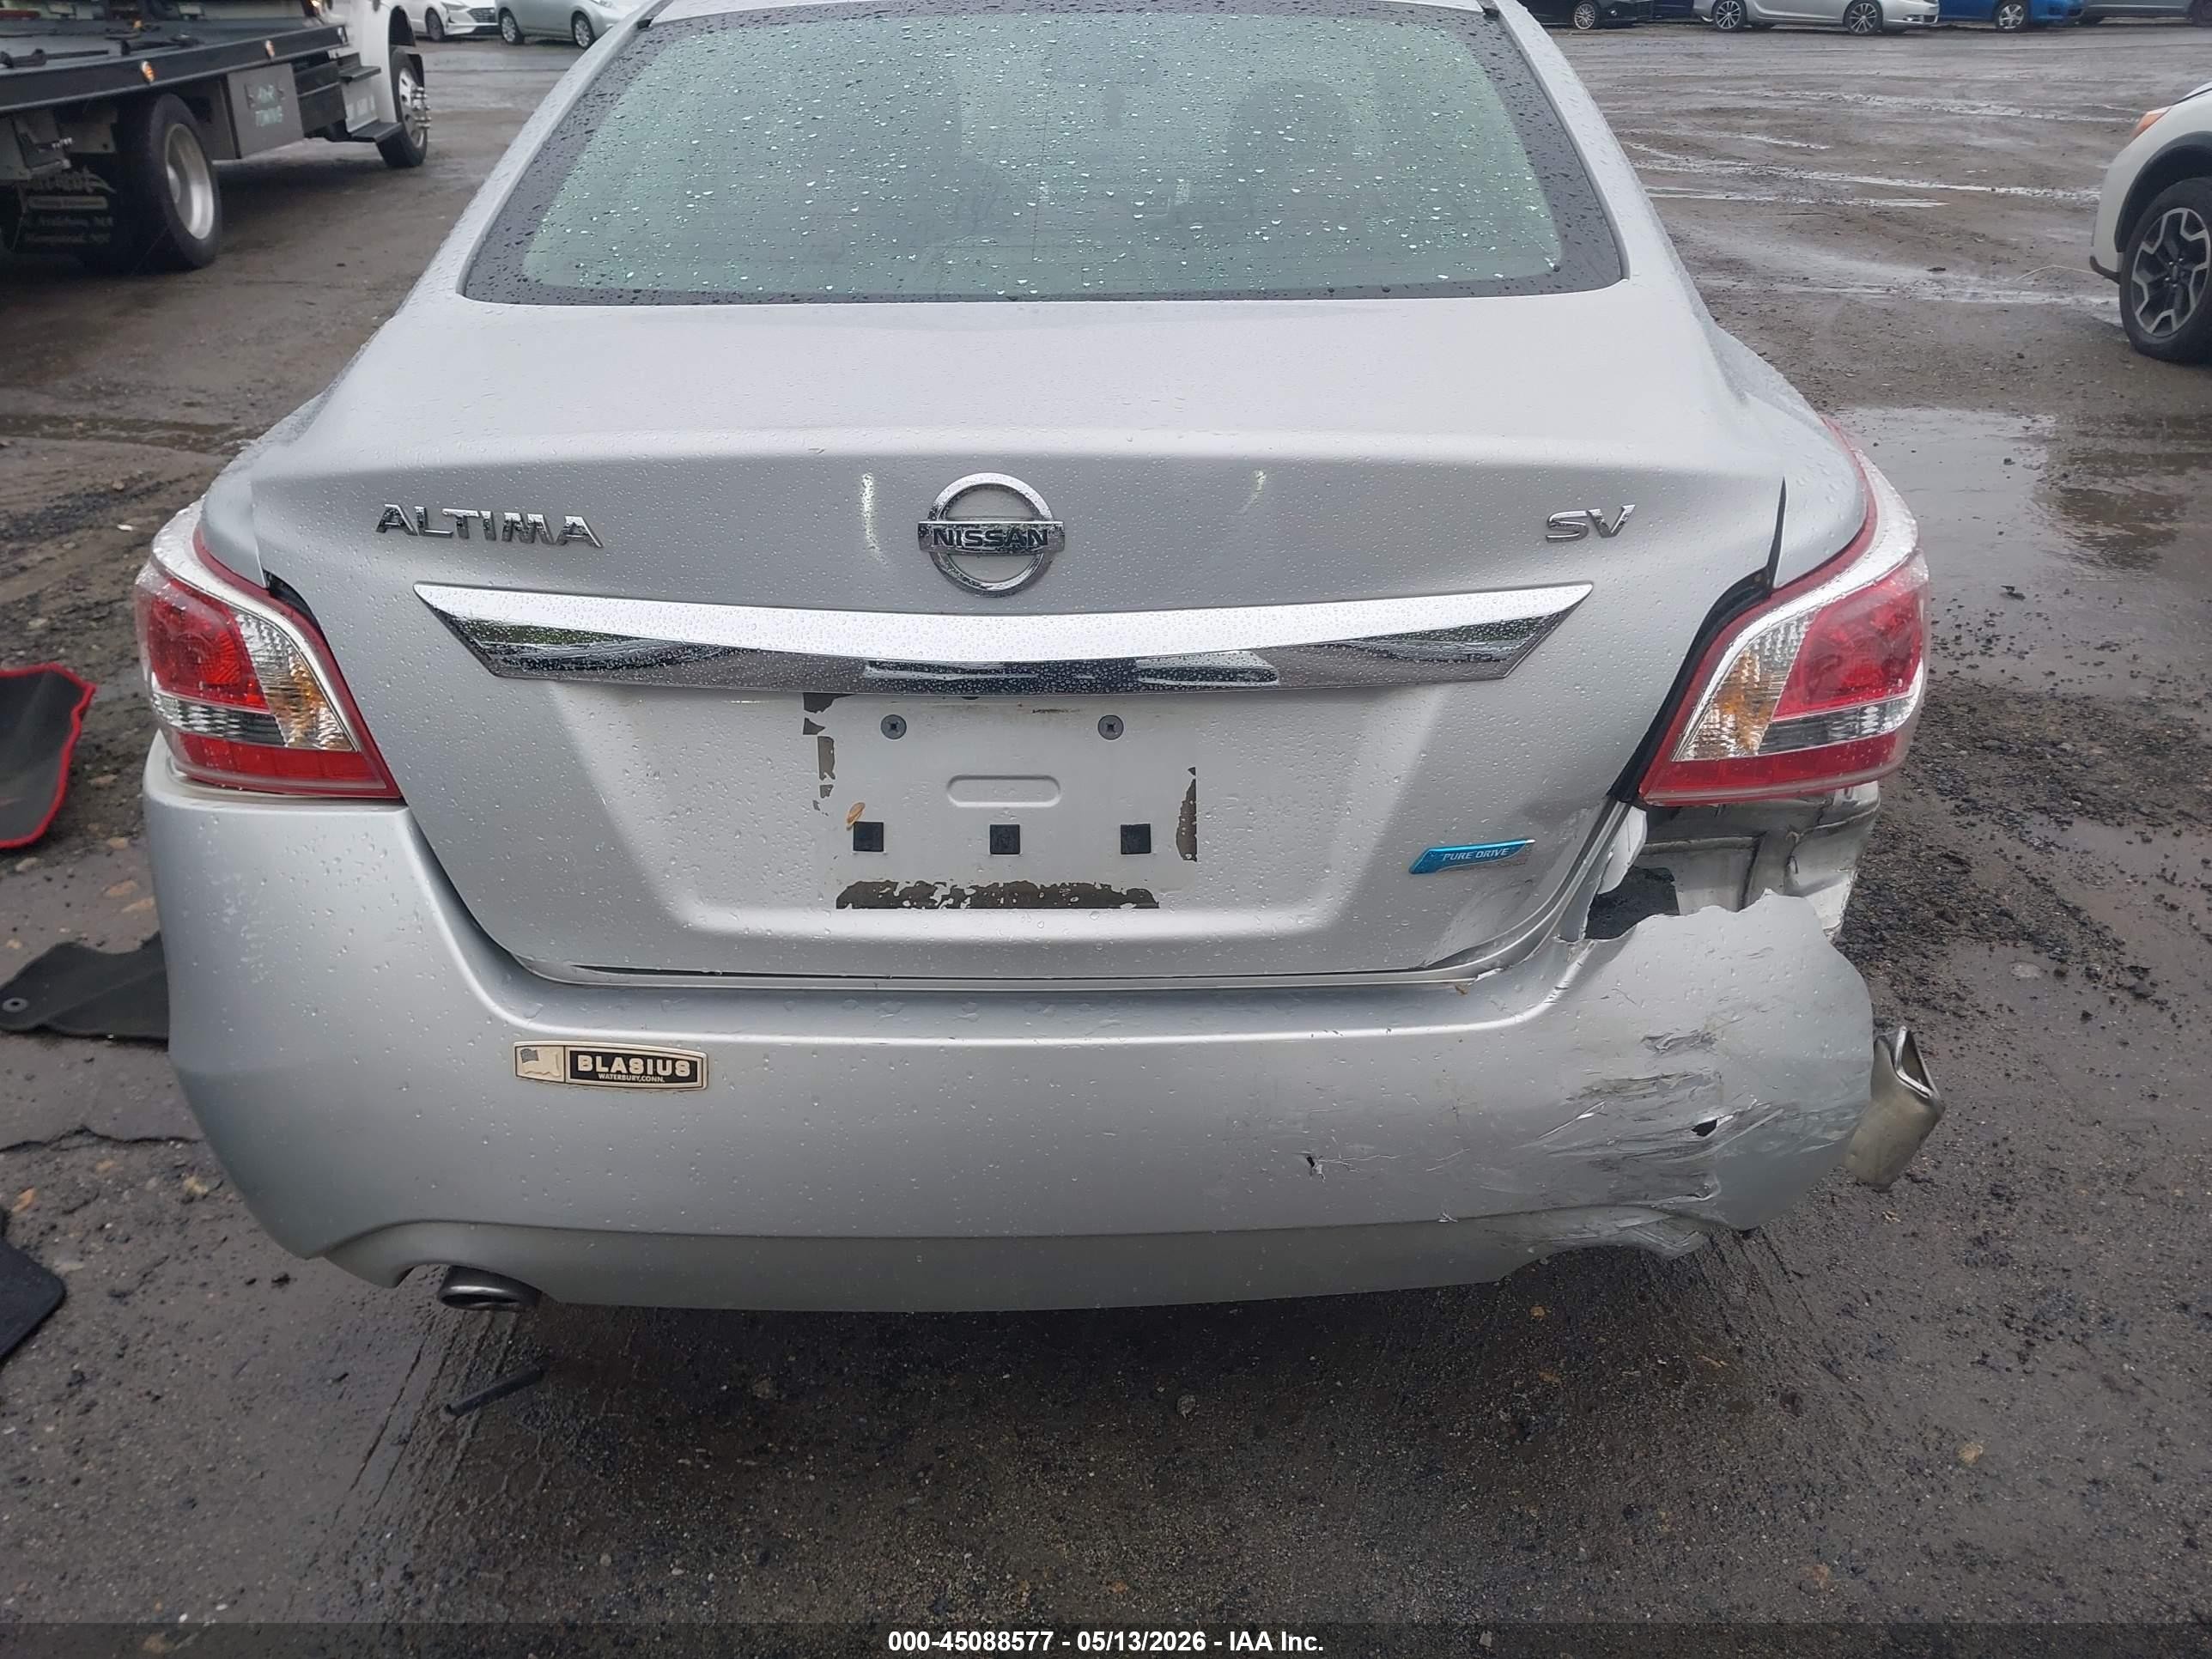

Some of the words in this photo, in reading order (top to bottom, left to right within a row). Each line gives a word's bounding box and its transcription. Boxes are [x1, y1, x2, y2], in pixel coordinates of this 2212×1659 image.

[376, 503, 604, 548] ALTIMA
[1546, 504, 1636, 543] SV
[933, 527, 1049, 547] NISSAN
[1442, 852, 1475, 861] PURE
[1475, 848, 1510, 859] DRIVE
[577, 1054, 690, 1077] BLASIUS
